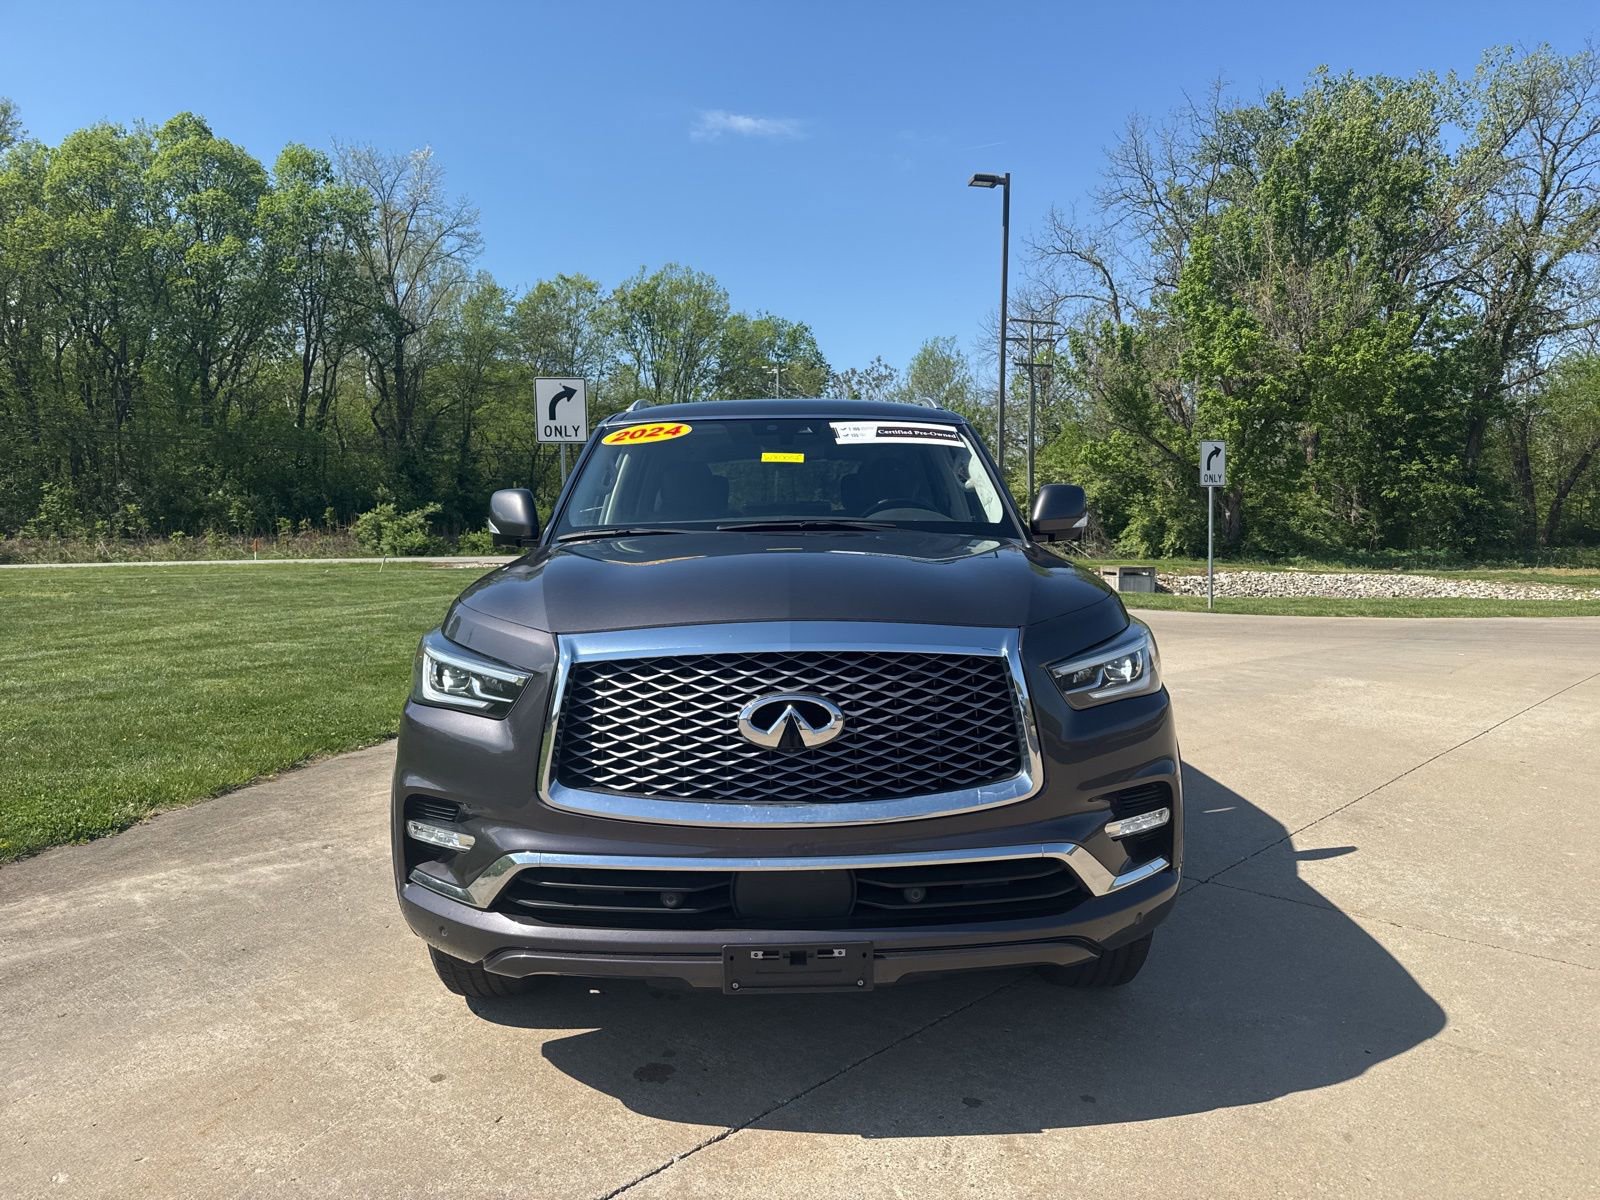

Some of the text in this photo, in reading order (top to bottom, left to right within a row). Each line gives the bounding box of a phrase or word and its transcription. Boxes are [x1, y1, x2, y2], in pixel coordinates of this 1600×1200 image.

[544, 425, 580, 437] ONLY
[610, 425, 684, 443] 2024
[914, 430, 957, 438] Pre-Owned
[1203, 473, 1222, 483] ONLY
